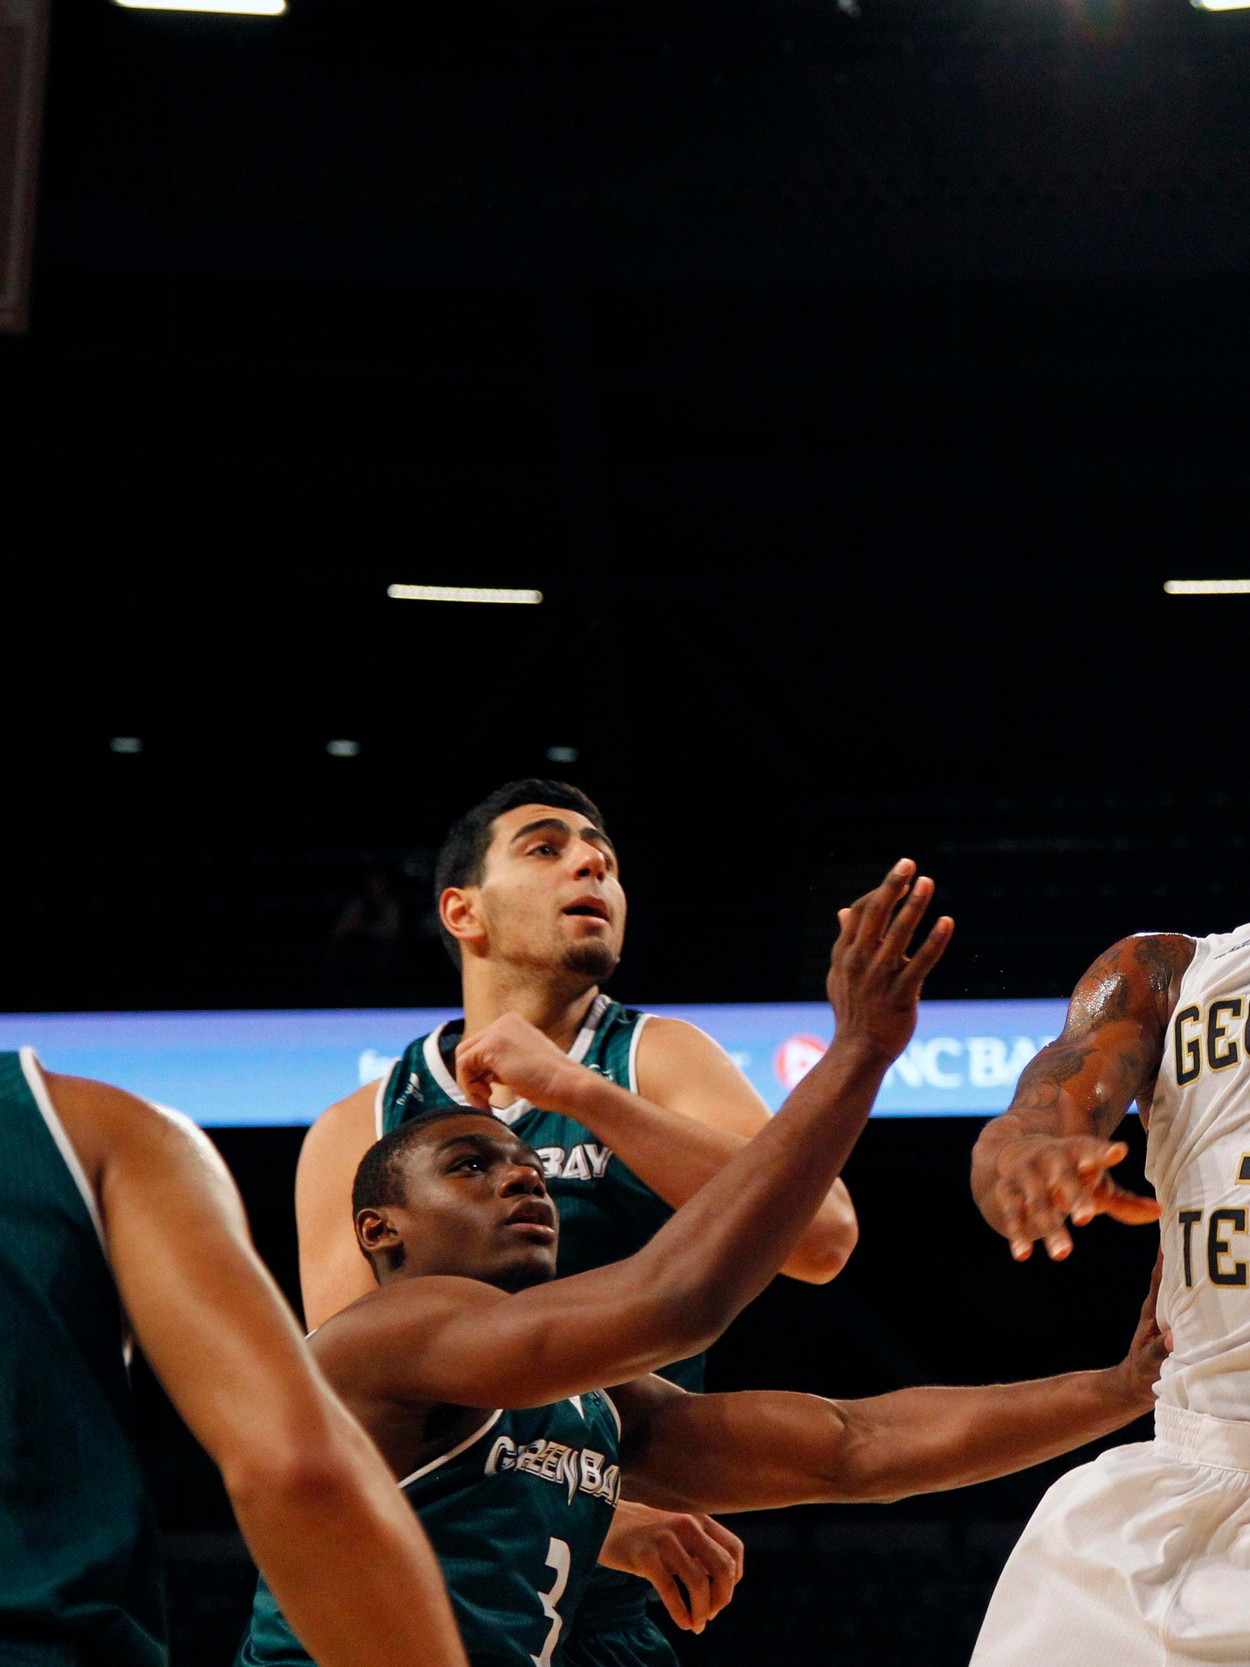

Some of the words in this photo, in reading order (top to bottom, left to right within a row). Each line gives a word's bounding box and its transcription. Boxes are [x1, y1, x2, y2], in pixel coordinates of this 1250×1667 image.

[882, 1036, 965, 1090] NC
[535, 1143, 613, 1181] BAY
[530, 1535, 572, 1667] 3
